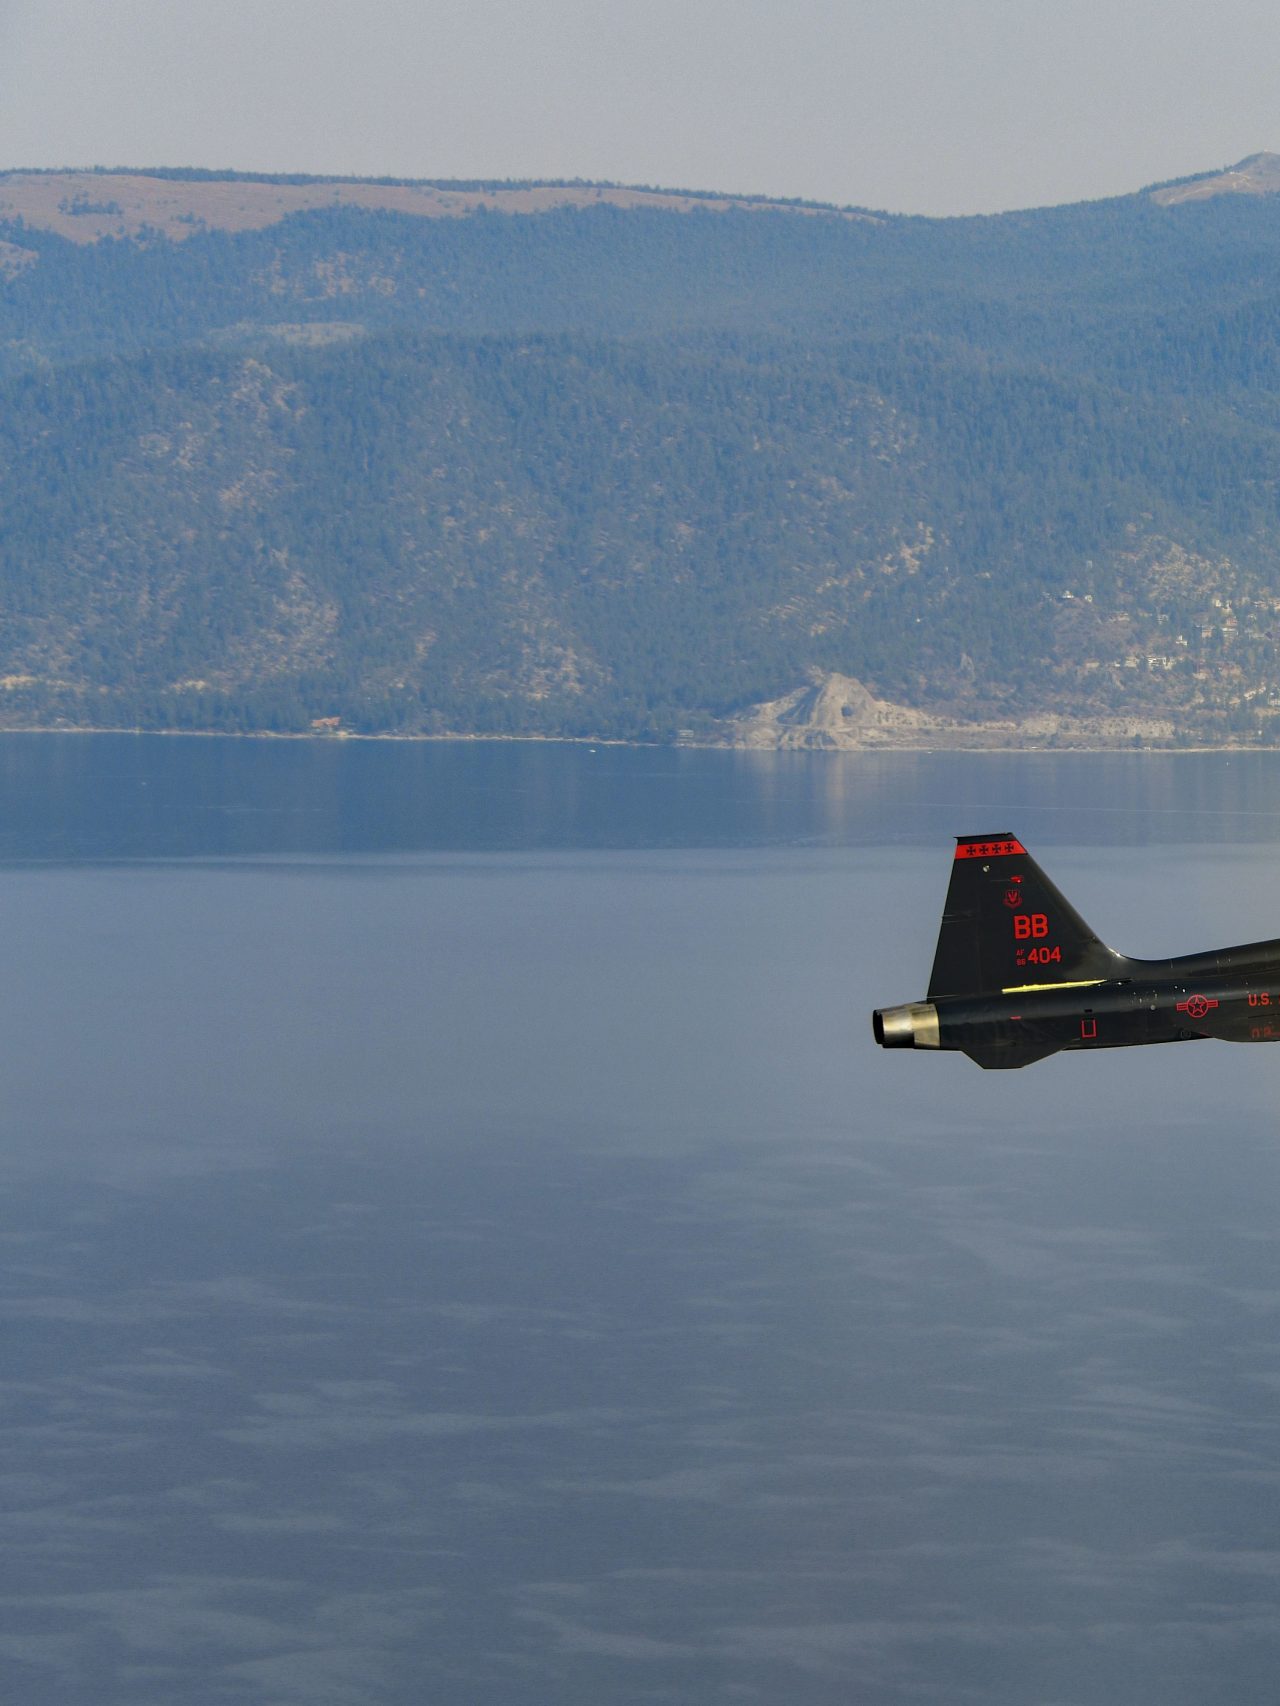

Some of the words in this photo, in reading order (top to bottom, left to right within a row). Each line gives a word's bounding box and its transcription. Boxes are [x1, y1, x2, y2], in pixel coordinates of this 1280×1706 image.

[1014, 913, 1048, 939] BB
[1028, 946, 1061, 964] 404
[1248, 992, 1273, 1006] U.S.
